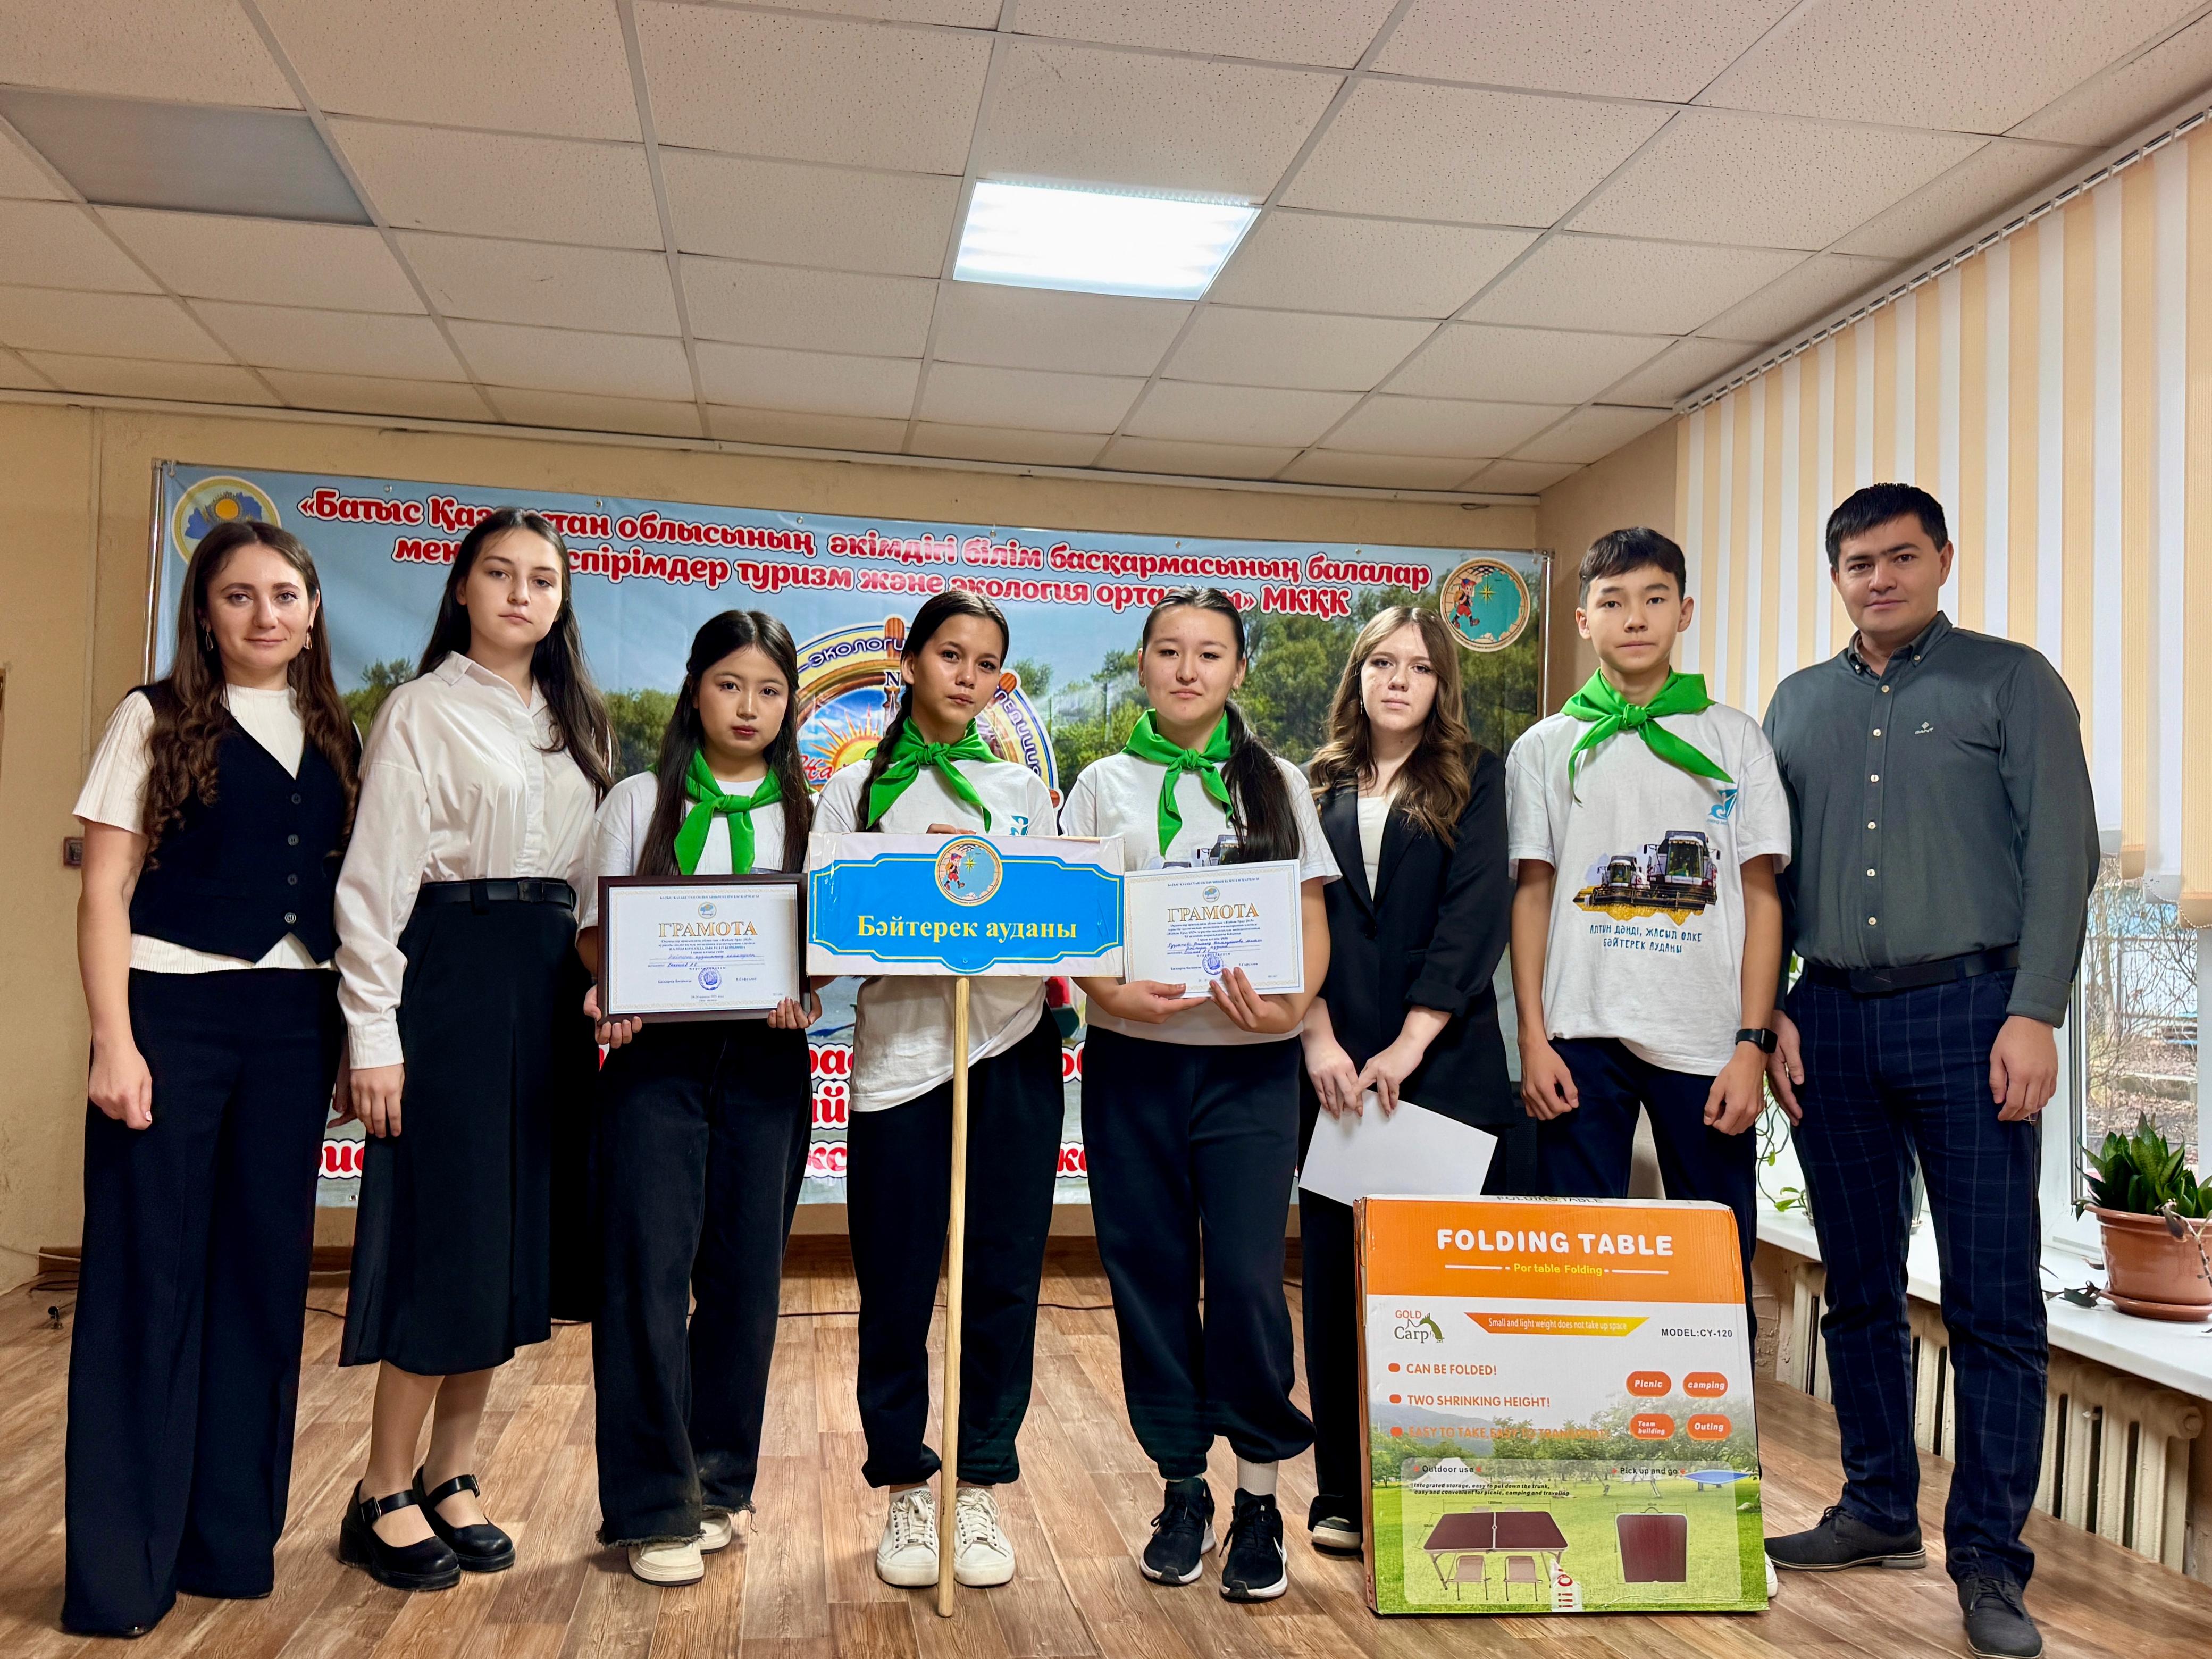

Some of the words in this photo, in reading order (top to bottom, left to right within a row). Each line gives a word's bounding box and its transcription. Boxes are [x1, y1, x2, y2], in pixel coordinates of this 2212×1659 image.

[300, 490, 422, 524] «Батыс
[430, 498, 610, 537] Қазтан
[617, 512, 815, 556] облысының
[830, 531, 957, 564] әкімдігі
[963, 537, 1042, 567] білім
[1050, 544, 1300, 583] басқармасының
[1308, 555, 1430, 591] балалар
[568, 546, 728, 588] спірімдер
[737, 562, 851, 591] туризм
[859, 571, 944, 593] және
[951, 576, 1088, 602] экология
[1096, 585, 1255, 610] ортаы»
[1262, 586, 1350, 619] МКҚК
[885, 671, 901, 687] N
[1167, 902, 1260, 923] ГРАМОТА
[658, 920, 758, 937] ГРАМОТА
[857, 915, 978, 943] Бәйтерек
[985, 921, 1077, 944] ауданы
[1590, 924, 1611, 934] АЛТЫН
[1614, 925, 1643, 937] ДӘНДІ,
[1645, 927, 1677, 940] ЖАСЫЛ
[1681, 931, 1702, 942] ӨЛКЕ
[1603, 937, 1646, 950] БӘЙТЕРЕК
[1649, 941, 1682, 953] АУДАНЫ
[1437, 1228, 1569, 1253] FOLDING
[1577, 1233, 1674, 1256] TABLE
[1564, 1264, 1603, 1277] Folding
[1395, 1309, 1422, 1319] GOLD
[1488, 1317, 1506, 1327] Small
[1506, 1318, 1519, 1328] and
[1520, 1318, 1535, 1329] light
[1535, 1319, 1557, 1330] weight
[1557, 1319, 1573, 1329] does
[1573, 1321, 1585, 1329] not
[1585, 1320, 1599, 1329] take
[1600, 1322, 1608, 1331] up
[1609, 1322, 1627, 1331] space
[1394, 1326, 1429, 1344] Carp
[1661, 1328, 1733, 1338] MODEL:CY-120
[1406, 1363, 1431, 1375] CAN
[1434, 1363, 1447, 1375] BE
[1449, 1364, 1497, 1376] FOLDED!
[1634, 1379, 1663, 1388] Picnic
[1687, 1380, 1725, 1391] camping
[1407, 1394, 1434, 1406] TWO
[1437, 1395, 1501, 1407] SHRINKING
[1504, 1396, 1551, 1408] HEIGHT!
[1409, 1426, 1438, 1438] EASY
[1439, 1426, 1455, 1438] TO
[1637, 1427, 1665, 1436] building
[1694, 1421, 1724, 1433] Outing
[1421, 1464, 1457, 1473] Outdoor
[1639, 1468, 1649, 1477] up
